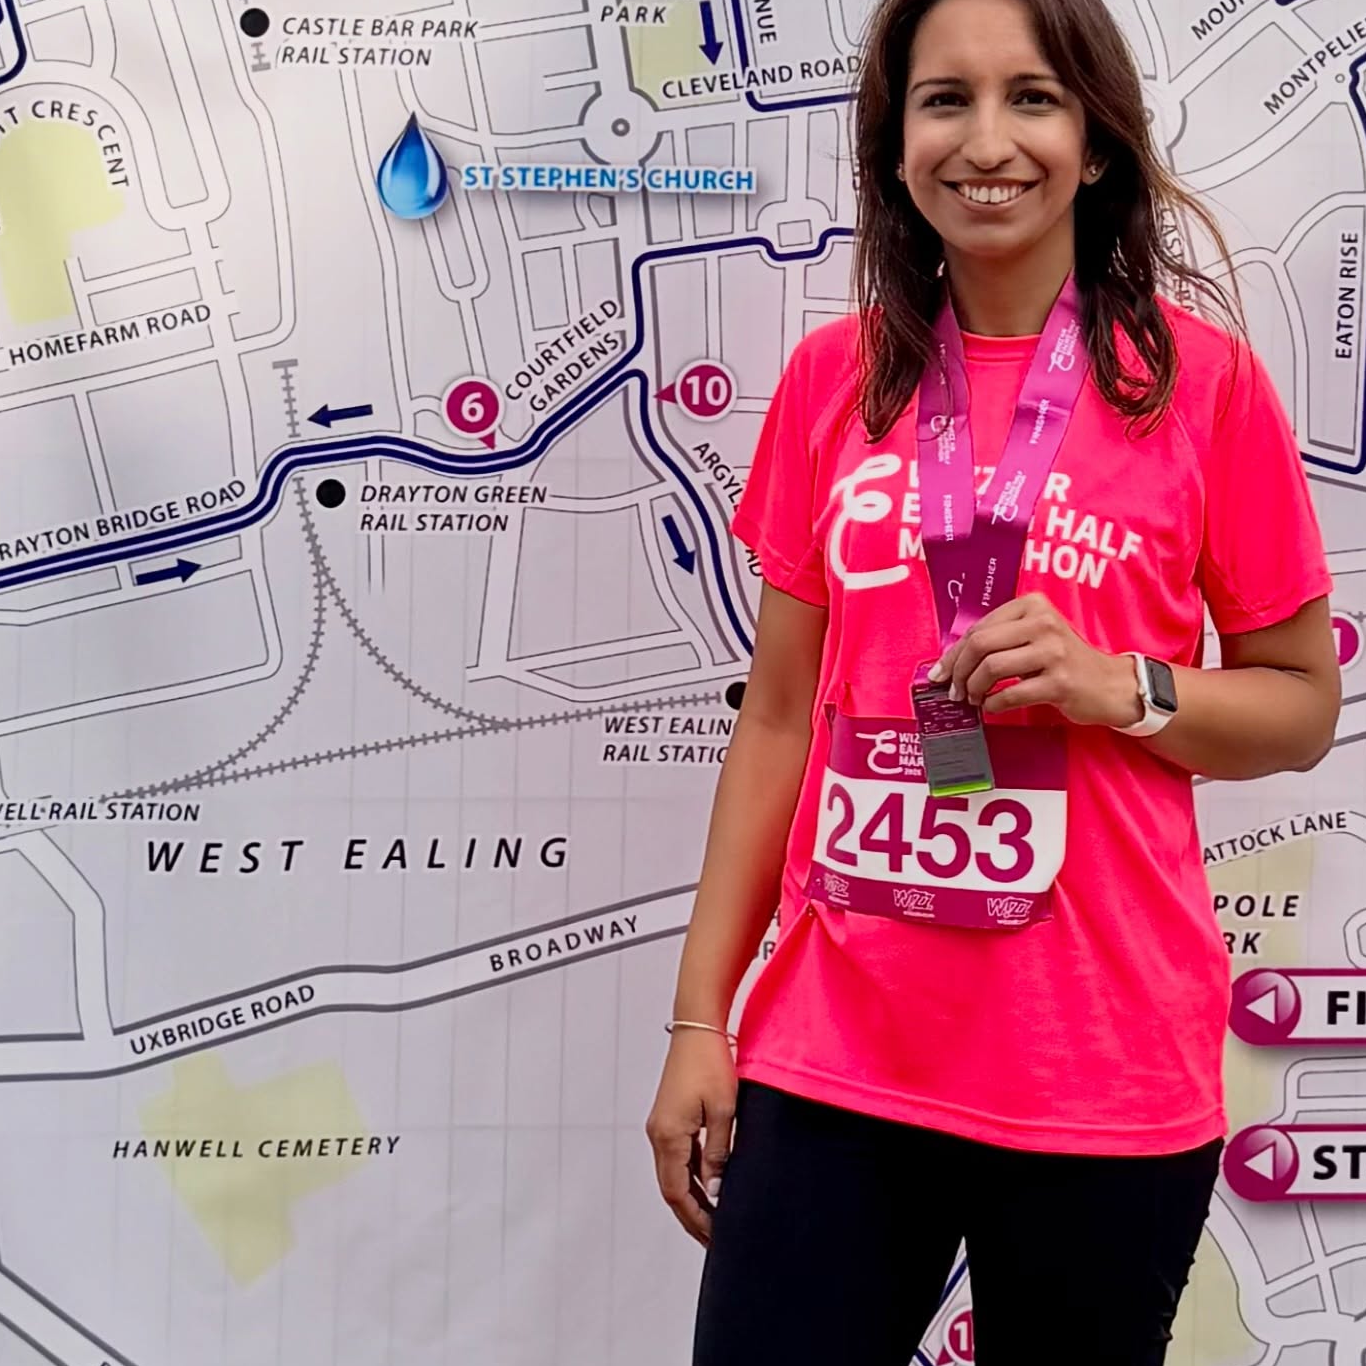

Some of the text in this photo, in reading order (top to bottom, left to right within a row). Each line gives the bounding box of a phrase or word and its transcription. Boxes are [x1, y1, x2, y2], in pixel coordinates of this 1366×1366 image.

[283, 17, 478, 39] CASTLE BAR PARK
[601, 6, 667, 24] PARK
[281, 46, 430, 65] RAIL STATION
[464, 168, 753, 190] ST STEPHEN'S CHURCH
[9, 304, 211, 365] HOMEFARM ROAD
[686, 377, 725, 404] 10
[462, 393, 483, 422] 6
[360, 485, 546, 504] DRAYTON GREEN
[97, 501, 179, 537] BRIDGE
[186, 480, 246, 515] ROAD
[360, 514, 508, 532] RAIL STATION
[1046, 505, 1143, 561] HALF
[48, 803, 98, 820] RAIL
[106, 803, 200, 821] STATION
[826, 783, 1034, 883] 2453
[147, 838, 568, 873] WEST EALING
[490, 916, 638, 972] BROADWAY
[130, 984, 315, 1056] UXBRIDGE ROAD
[113, 1137, 401, 1159] HANWELL CEMETERY
